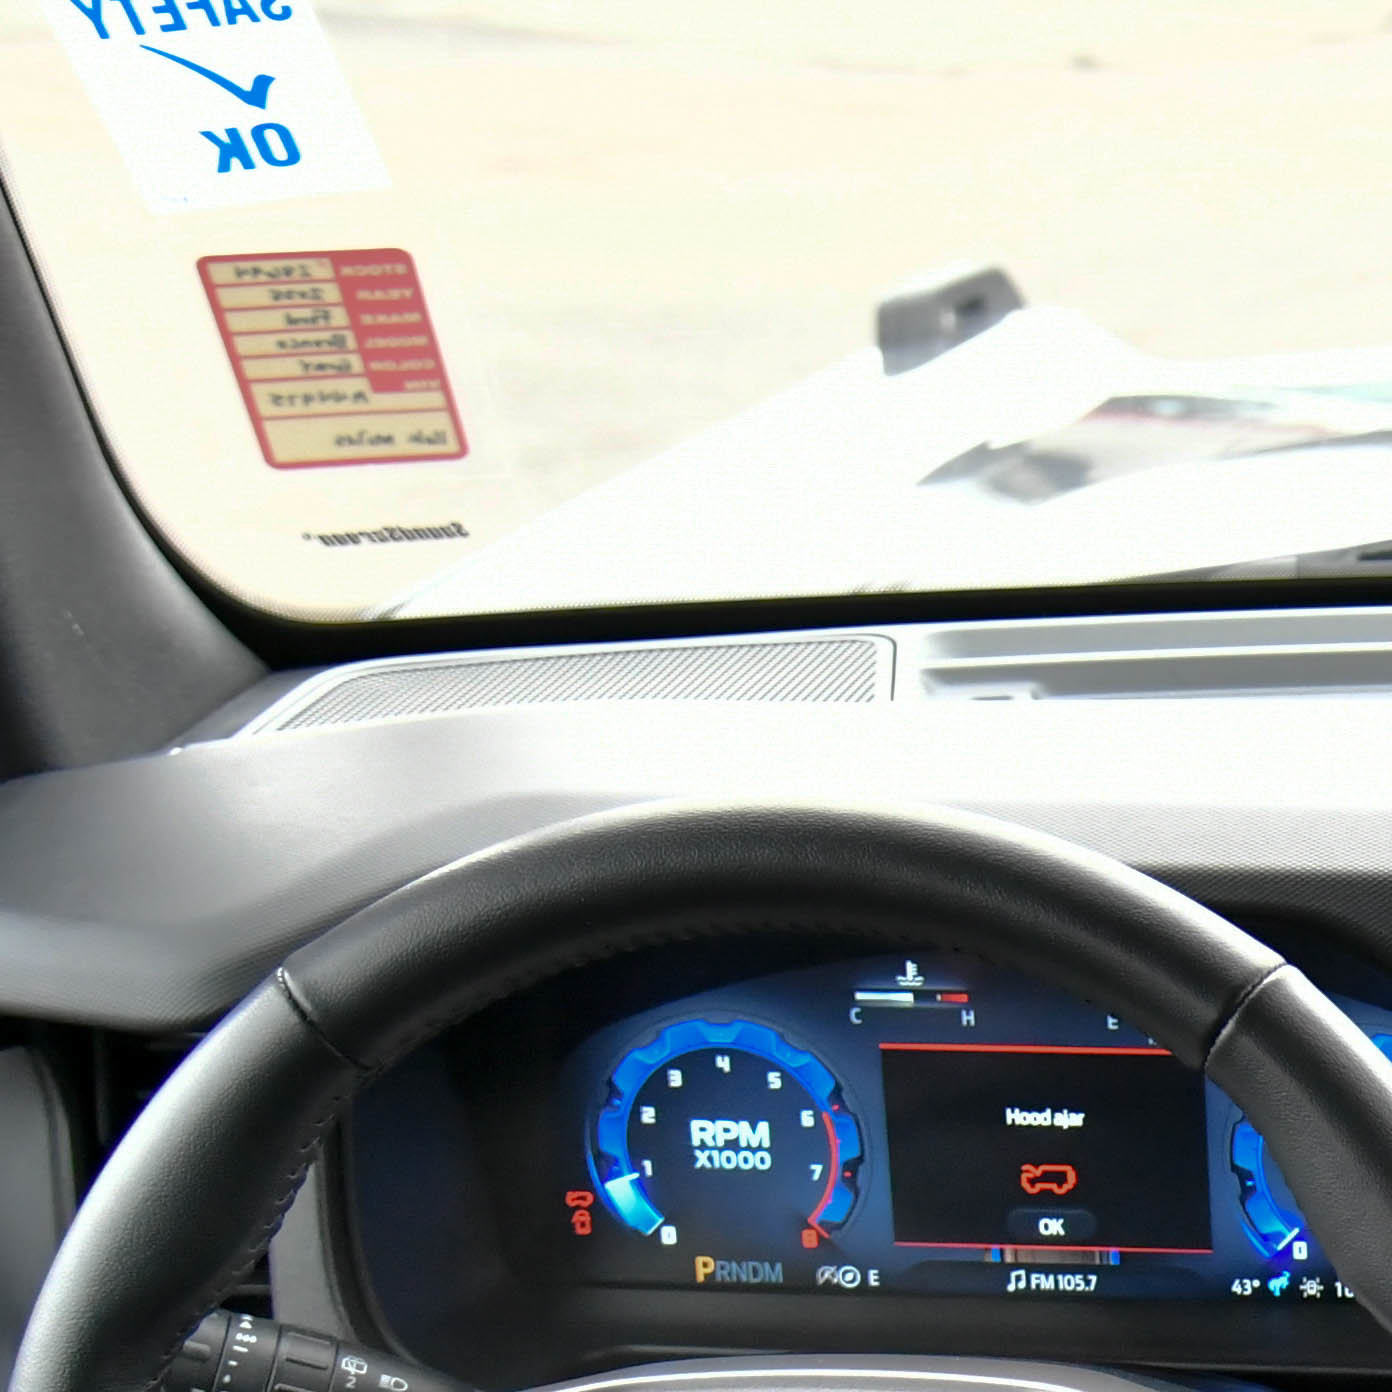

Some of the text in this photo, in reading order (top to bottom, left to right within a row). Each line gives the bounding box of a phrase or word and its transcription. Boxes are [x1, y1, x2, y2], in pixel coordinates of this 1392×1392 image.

[848, 1007, 862, 1025] C
[960, 1009, 976, 1027] H
[716, 1055, 731, 1073] 4
[667, 1069, 683, 1088] 3
[766, 1071, 783, 1090] 5
[639, 1105, 656, 1125] 2
[800, 1109, 816, 1128] 6
[1005, 1109, 1086, 1130] Hood ajar
[690, 1119, 771, 1149] RPM
[641, 1160, 653, 1177] 1
[694, 1149, 772, 1170] X1000
[810, 1164, 823, 1181] 7
[1038, 1217, 1065, 1237] OK
[867, 1270, 880, 1286] E
[1030, 1274, 1098, 1292] FM 105.7
[1231, 1278, 1261, 1296] 43°
